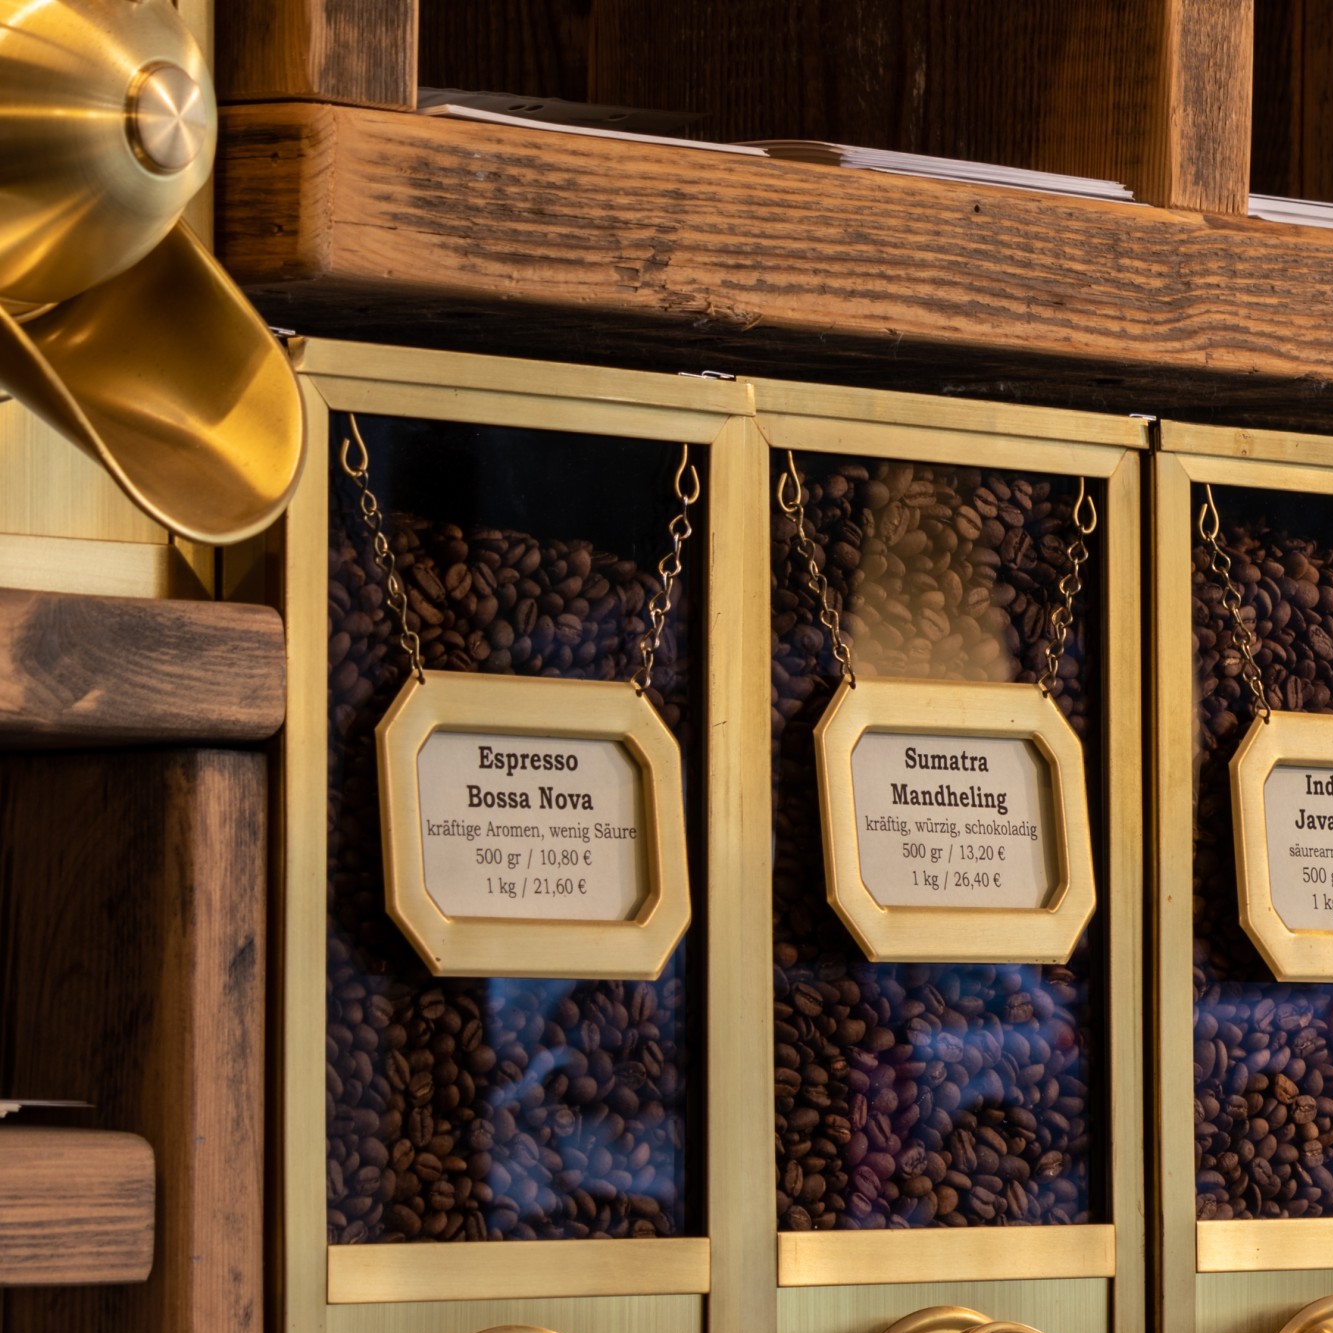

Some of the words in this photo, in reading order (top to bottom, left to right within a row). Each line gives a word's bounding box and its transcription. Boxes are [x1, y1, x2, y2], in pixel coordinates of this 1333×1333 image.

[478, 746, 578, 776] Espresso
[905, 748, 989, 772] Sumatra
[467, 785, 531, 809] Bossa
[538, 787, 593, 810] Nova
[891, 783, 1008, 815] Mandheling
[427, 820, 481, 841] kräftige
[486, 821, 544, 839] Aromen,
[549, 825, 590, 843] wenig
[594, 823, 637, 840] Säure
[865, 816, 911, 836] kräftig,
[915, 818, 960, 838] würzig,
[965, 819, 1038, 840] schokoladig
[476, 849, 502, 865] 500
[507, 851, 521, 869] gr
[527, 849, 532, 869] /
[540, 850, 579, 867] 10,80
[583, 851, 592, 865] €
[903, 843, 926, 858] 500
[931, 847, 943, 863] gr
[949, 844, 953, 863] /
[960, 845, 993, 862] 13,20
[998, 846, 1006, 860] €
[913, 871, 918, 885] 1
[924, 871, 939, 890] kg
[944, 871, 949, 890] /
[954, 872, 989, 889] 26,40
[993, 873, 1001, 887] €
[1303, 867, 1326, 883] 500
[487, 878, 492, 893] 1
[499, 877, 516, 897] kg
[522, 878, 527, 897] /
[534, 879, 573, 896] 21,60
[577, 879, 587, 894] €
[1313, 894, 1318, 909] 1
